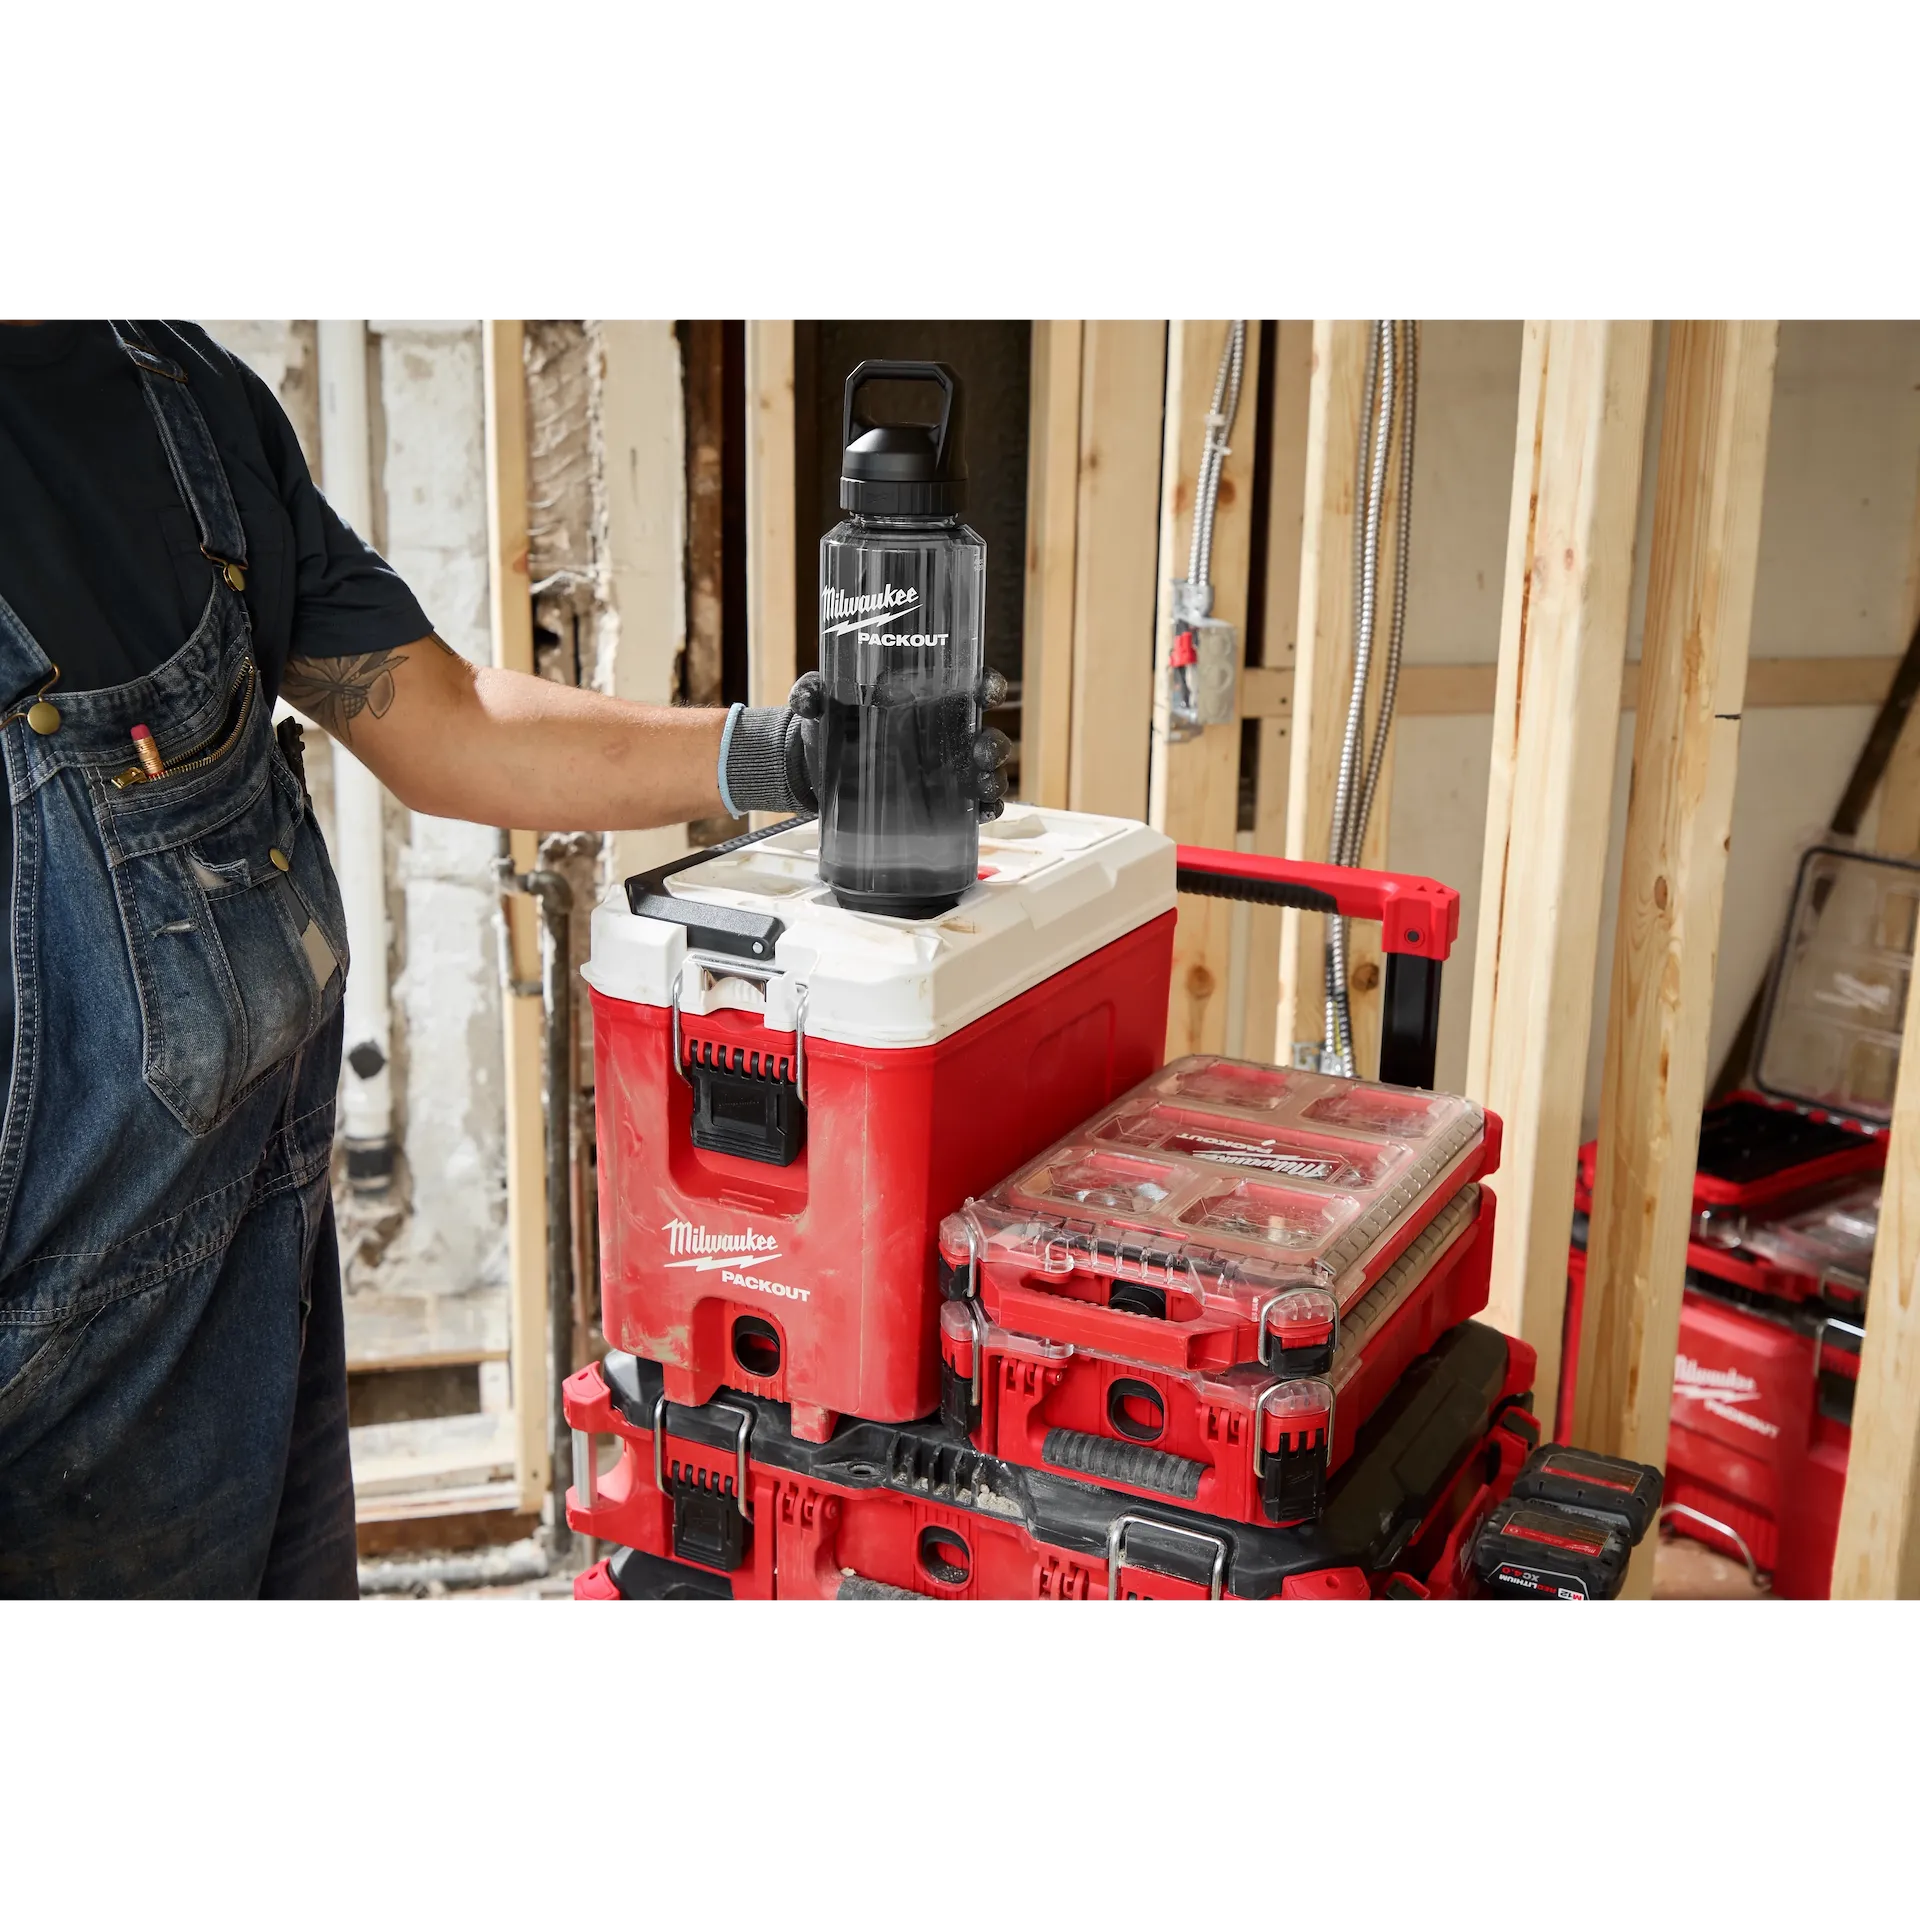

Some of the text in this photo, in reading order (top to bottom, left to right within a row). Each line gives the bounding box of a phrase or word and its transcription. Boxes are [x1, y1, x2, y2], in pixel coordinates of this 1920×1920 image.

[821, 583, 920, 623] Milwaukee
[857, 632, 949, 647] PACKOUT
[1176, 1133, 1274, 1154] PACKOUT
[661, 1217, 779, 1256] Milwaukee
[721, 1269, 811, 1302] PACKOUT
[1498, 1573, 1583, 1602] M12 REDLITHIUM
